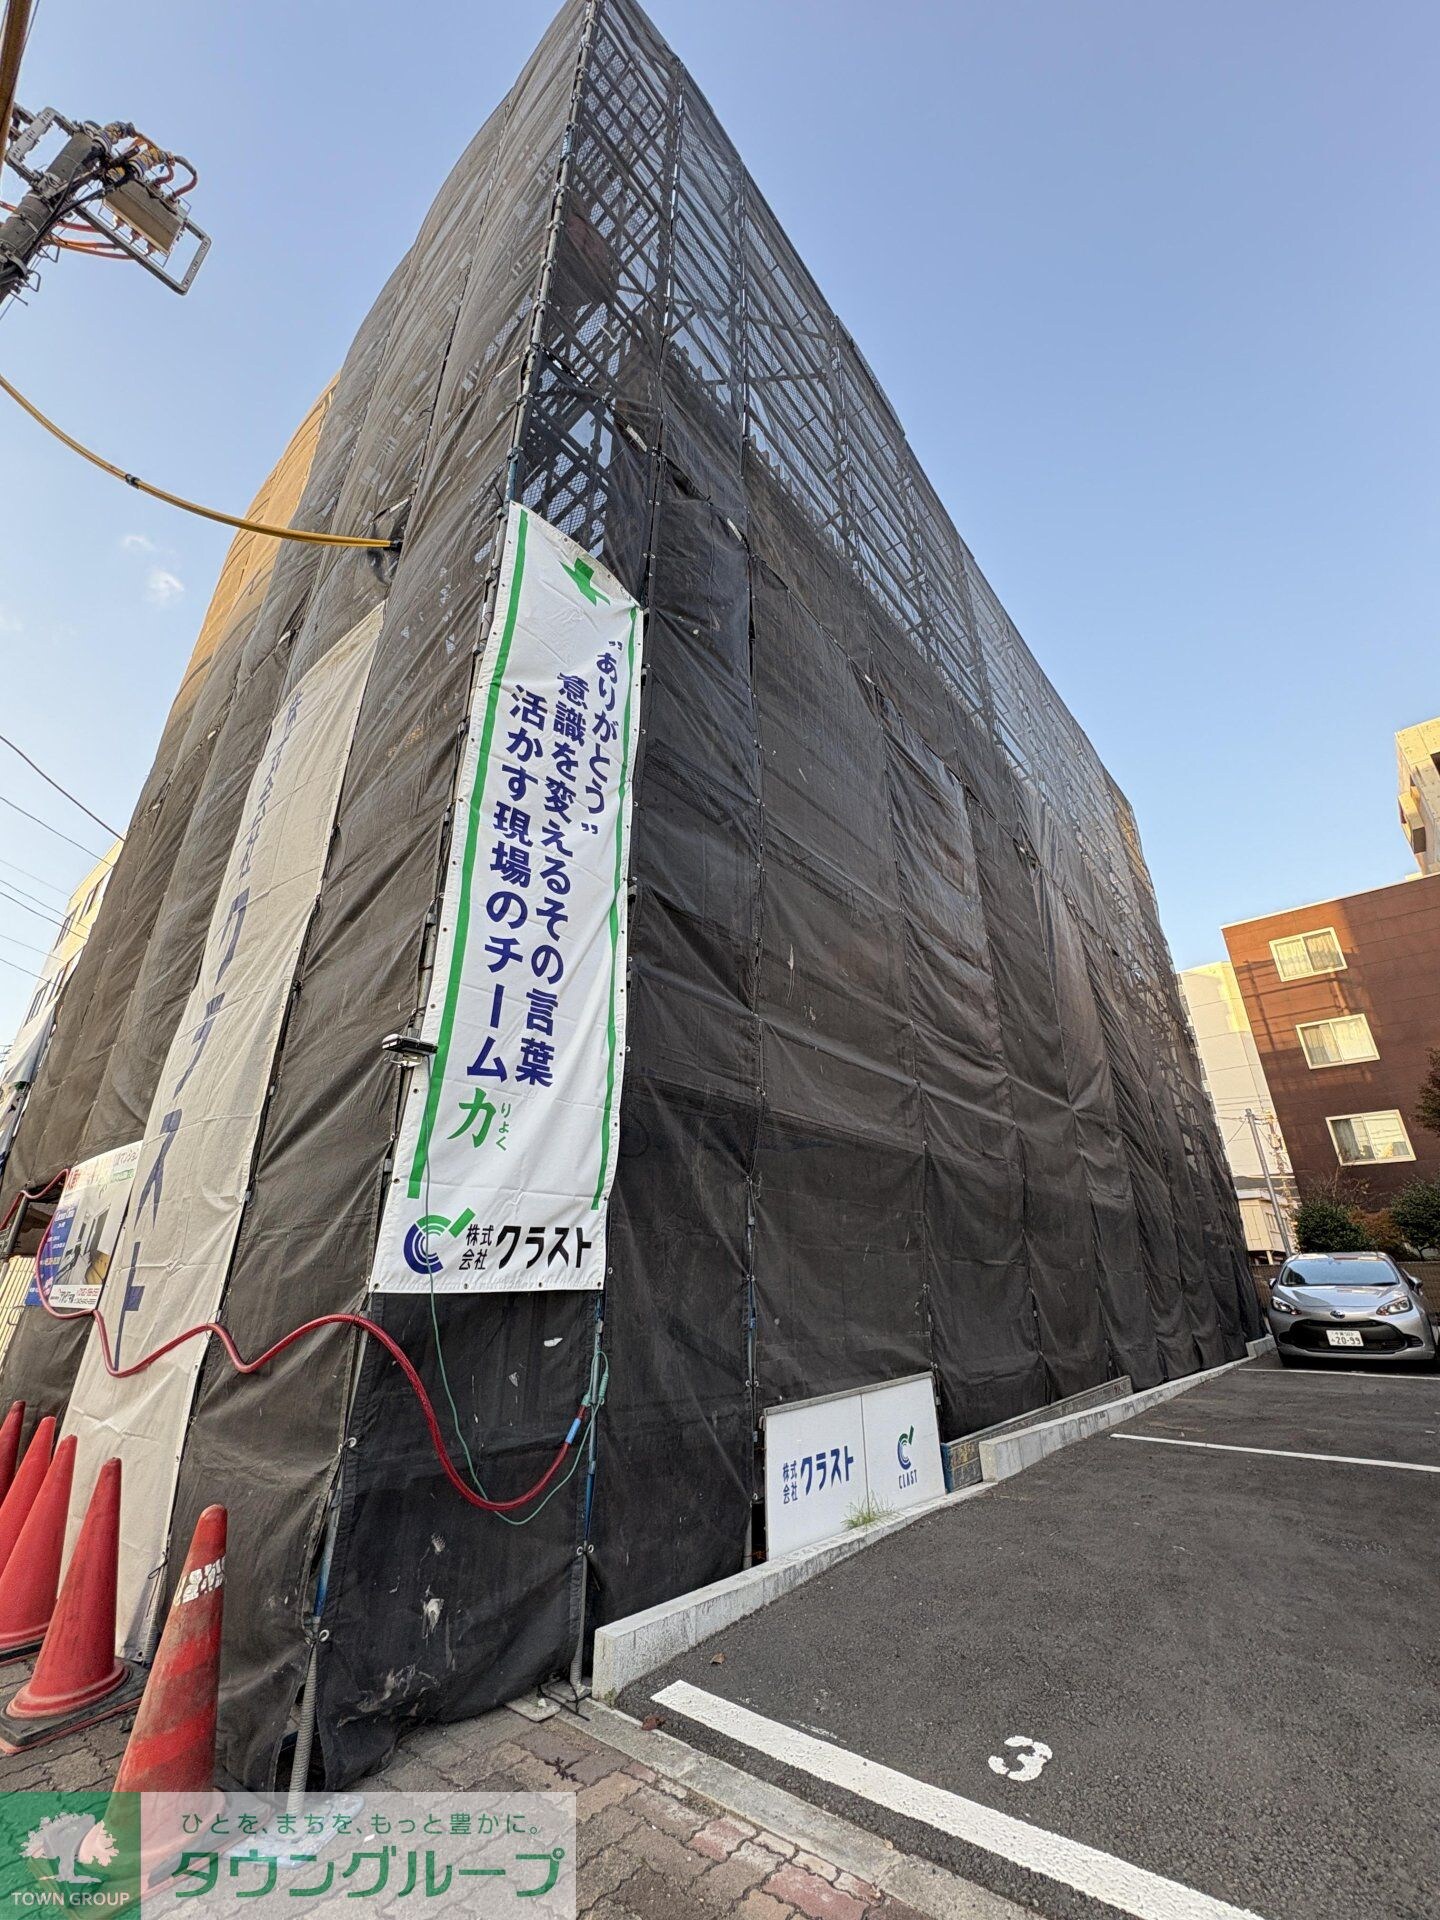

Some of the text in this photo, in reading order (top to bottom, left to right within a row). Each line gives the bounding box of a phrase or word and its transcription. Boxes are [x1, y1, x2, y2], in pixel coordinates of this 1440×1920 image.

[515, 672, 590, 1088] 意識を変えるその言葉
[495, 1101, 512, 1151] りょく
[898, 1468, 918, 1490] CLAST
[987, 1735, 1053, 1782] 3
